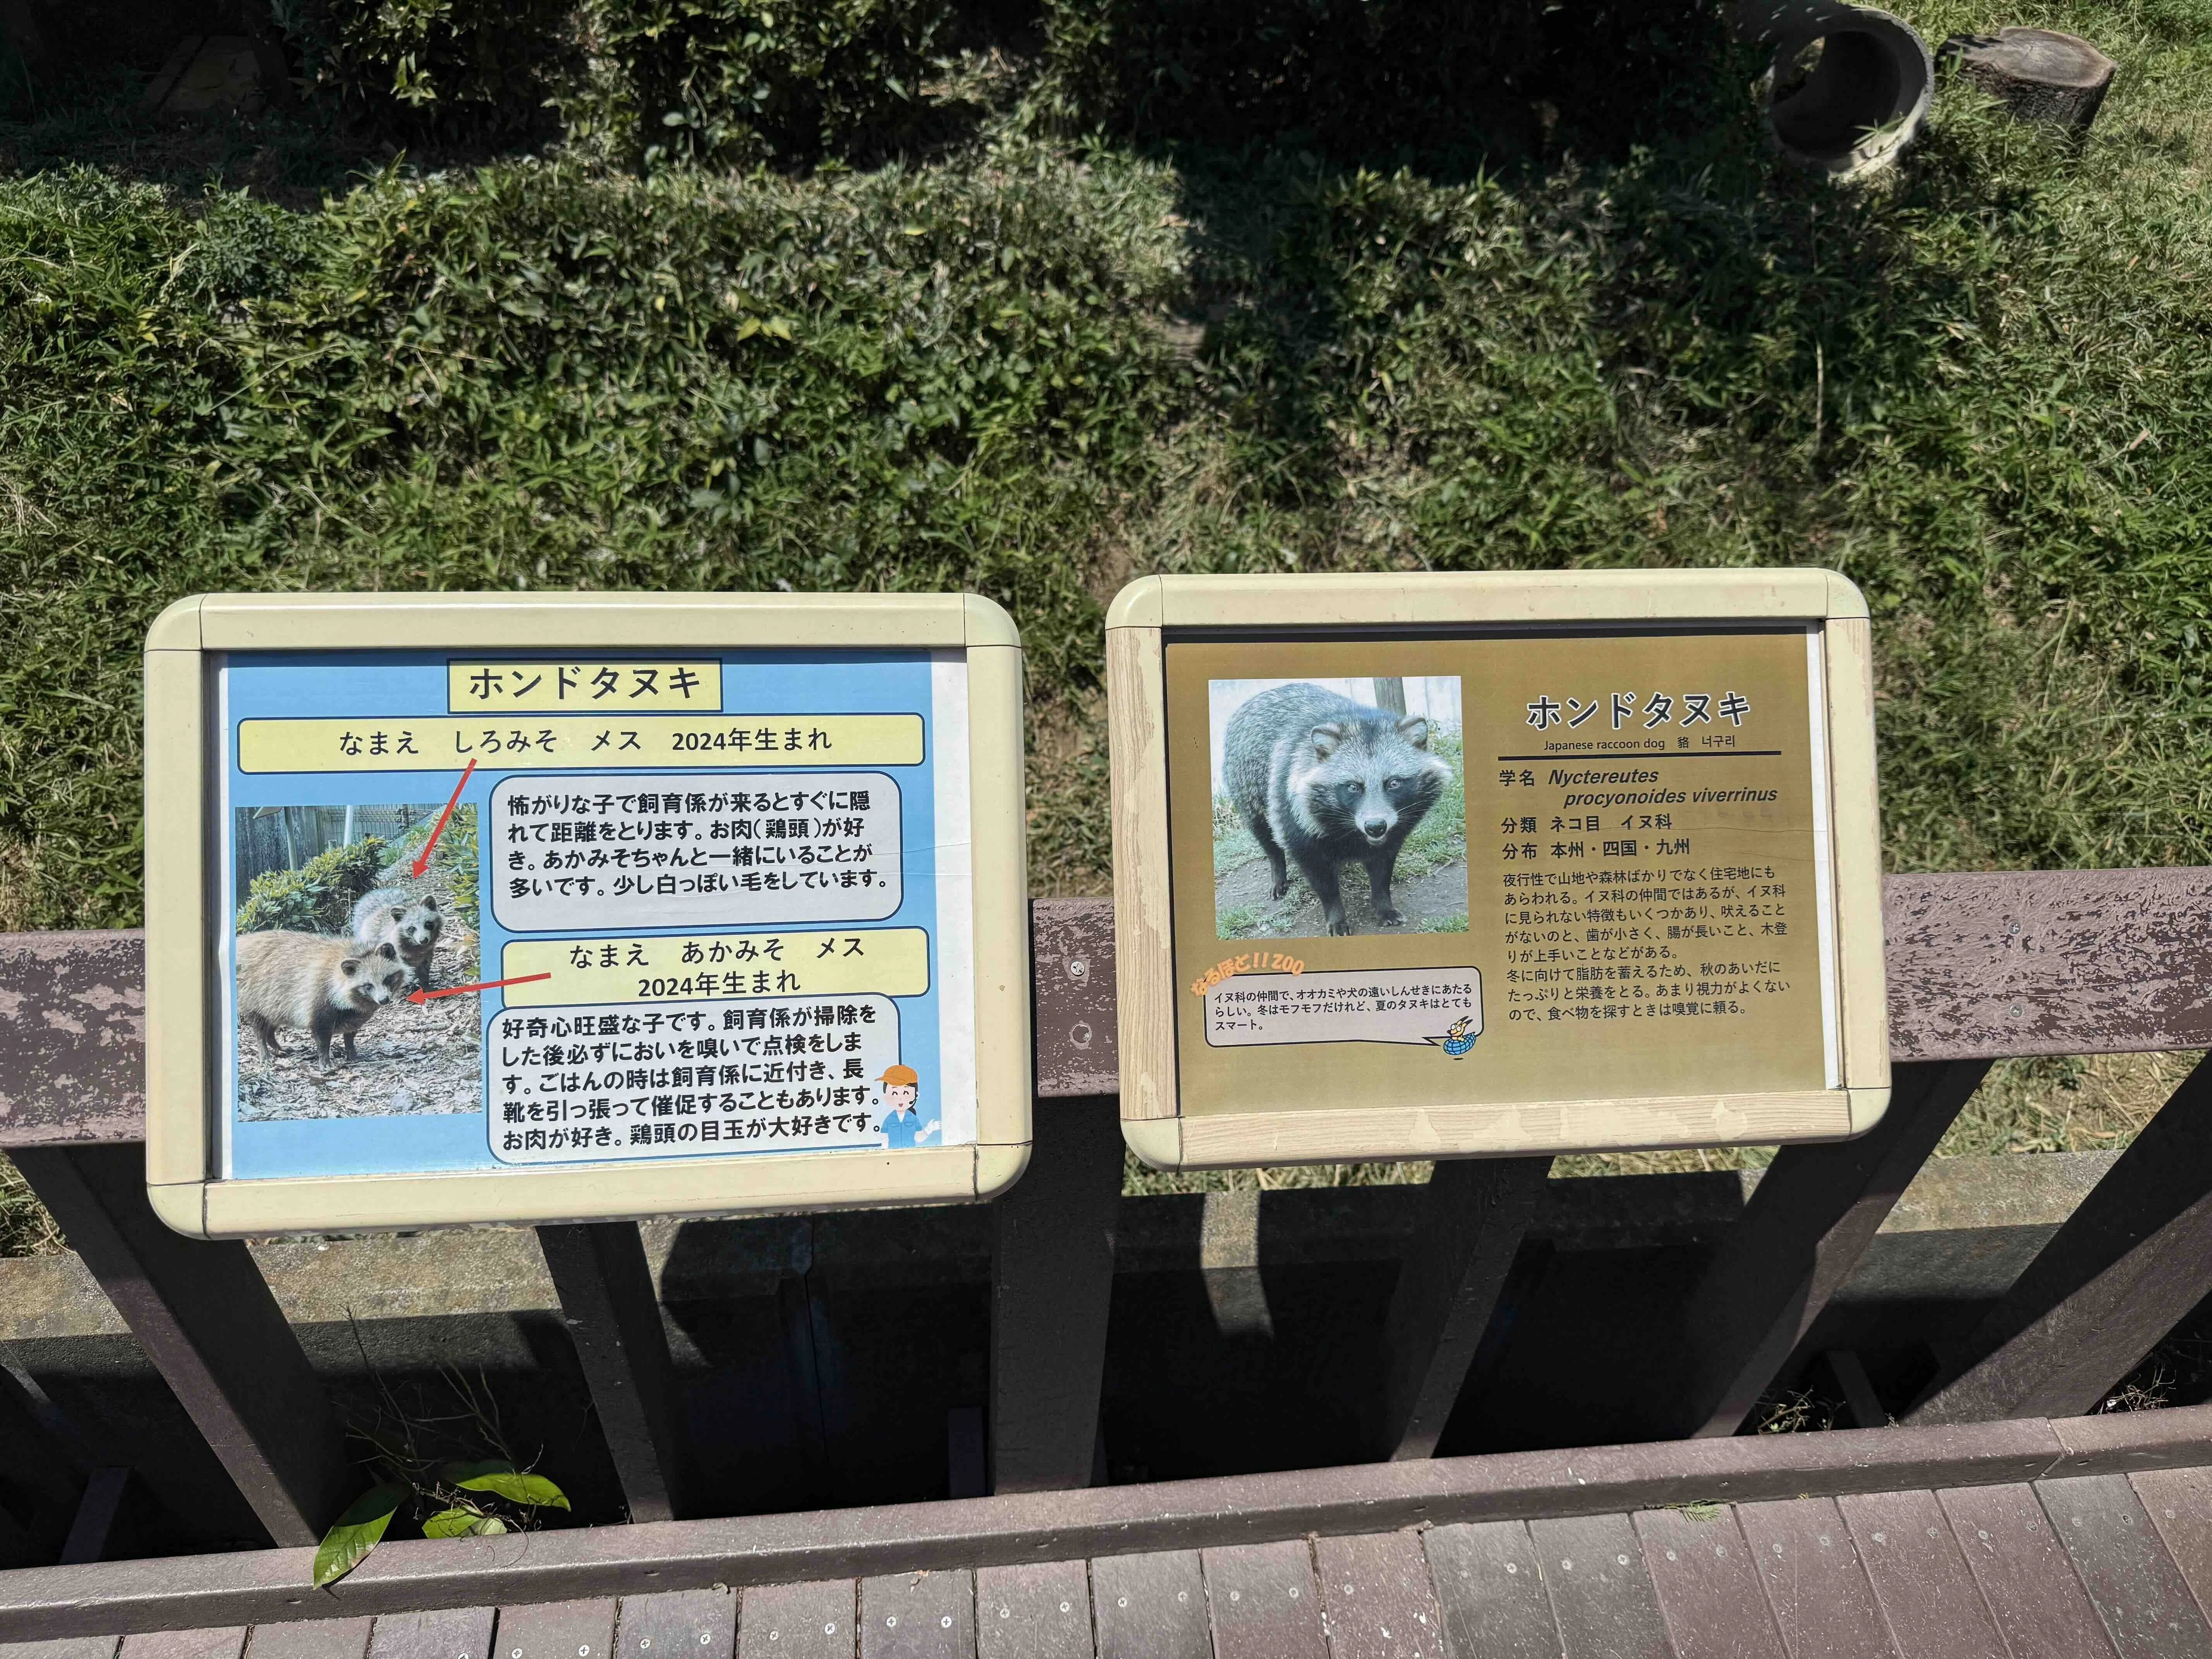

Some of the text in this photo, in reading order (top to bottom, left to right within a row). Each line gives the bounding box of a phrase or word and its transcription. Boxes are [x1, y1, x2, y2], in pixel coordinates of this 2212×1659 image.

[469, 666, 700, 700] ホンドタヌキ
[1525, 690, 1751, 732] ホンドタヌキ
[339, 727, 833, 756] なまえ しろみそ メス 2024年生まれ
[1543, 740, 1594, 753] Japanese
[1596, 740, 1641, 750] raccoon
[1643, 737, 1665, 751] dog
[1702, 735, 1735, 748] 너구리
[1499, 768, 1659, 788] 学名 Nyctereutes
[507, 790, 871, 817] 怖がりな子で飼育係が来るとすぐに隠
[1563, 786, 1778, 809] procyonoides viverrinus
[1500, 813, 1673, 834] 分類 ネコ目 イヌ科
[508, 843, 873, 871] き。あかみそちゃんと一緒にいることが
[1501, 842, 1538, 860] 分布
[509, 868, 886, 899] 多いです。少し白っぽい毛をしています。
[569, 937, 864, 969] なまえ あかみそ メス
[1508, 945, 1677, 964] りが上手いことなどがある。
[638, 969, 801, 997] 2024年生まれ
[501, 1004, 876, 1040] 好奇心旺盛な子です。飼育係が掃除を
[1215, 1018, 1263, 1031] スマート。
[1509, 1000, 1745, 1022] ので、食べ物を探すときは嗅覚に頼る。
[502, 1031, 862, 1067] した後必ずにおいを嗅いで点検をしま
[501, 1058, 864, 1095] す。ごはんの時は飼育係に近付き、長
[503, 1085, 879, 1124] 靴を引っ張って催促することもあります。
[503, 1112, 880, 1151] お肉が好き。鶏頭の目玉が大好きです。
